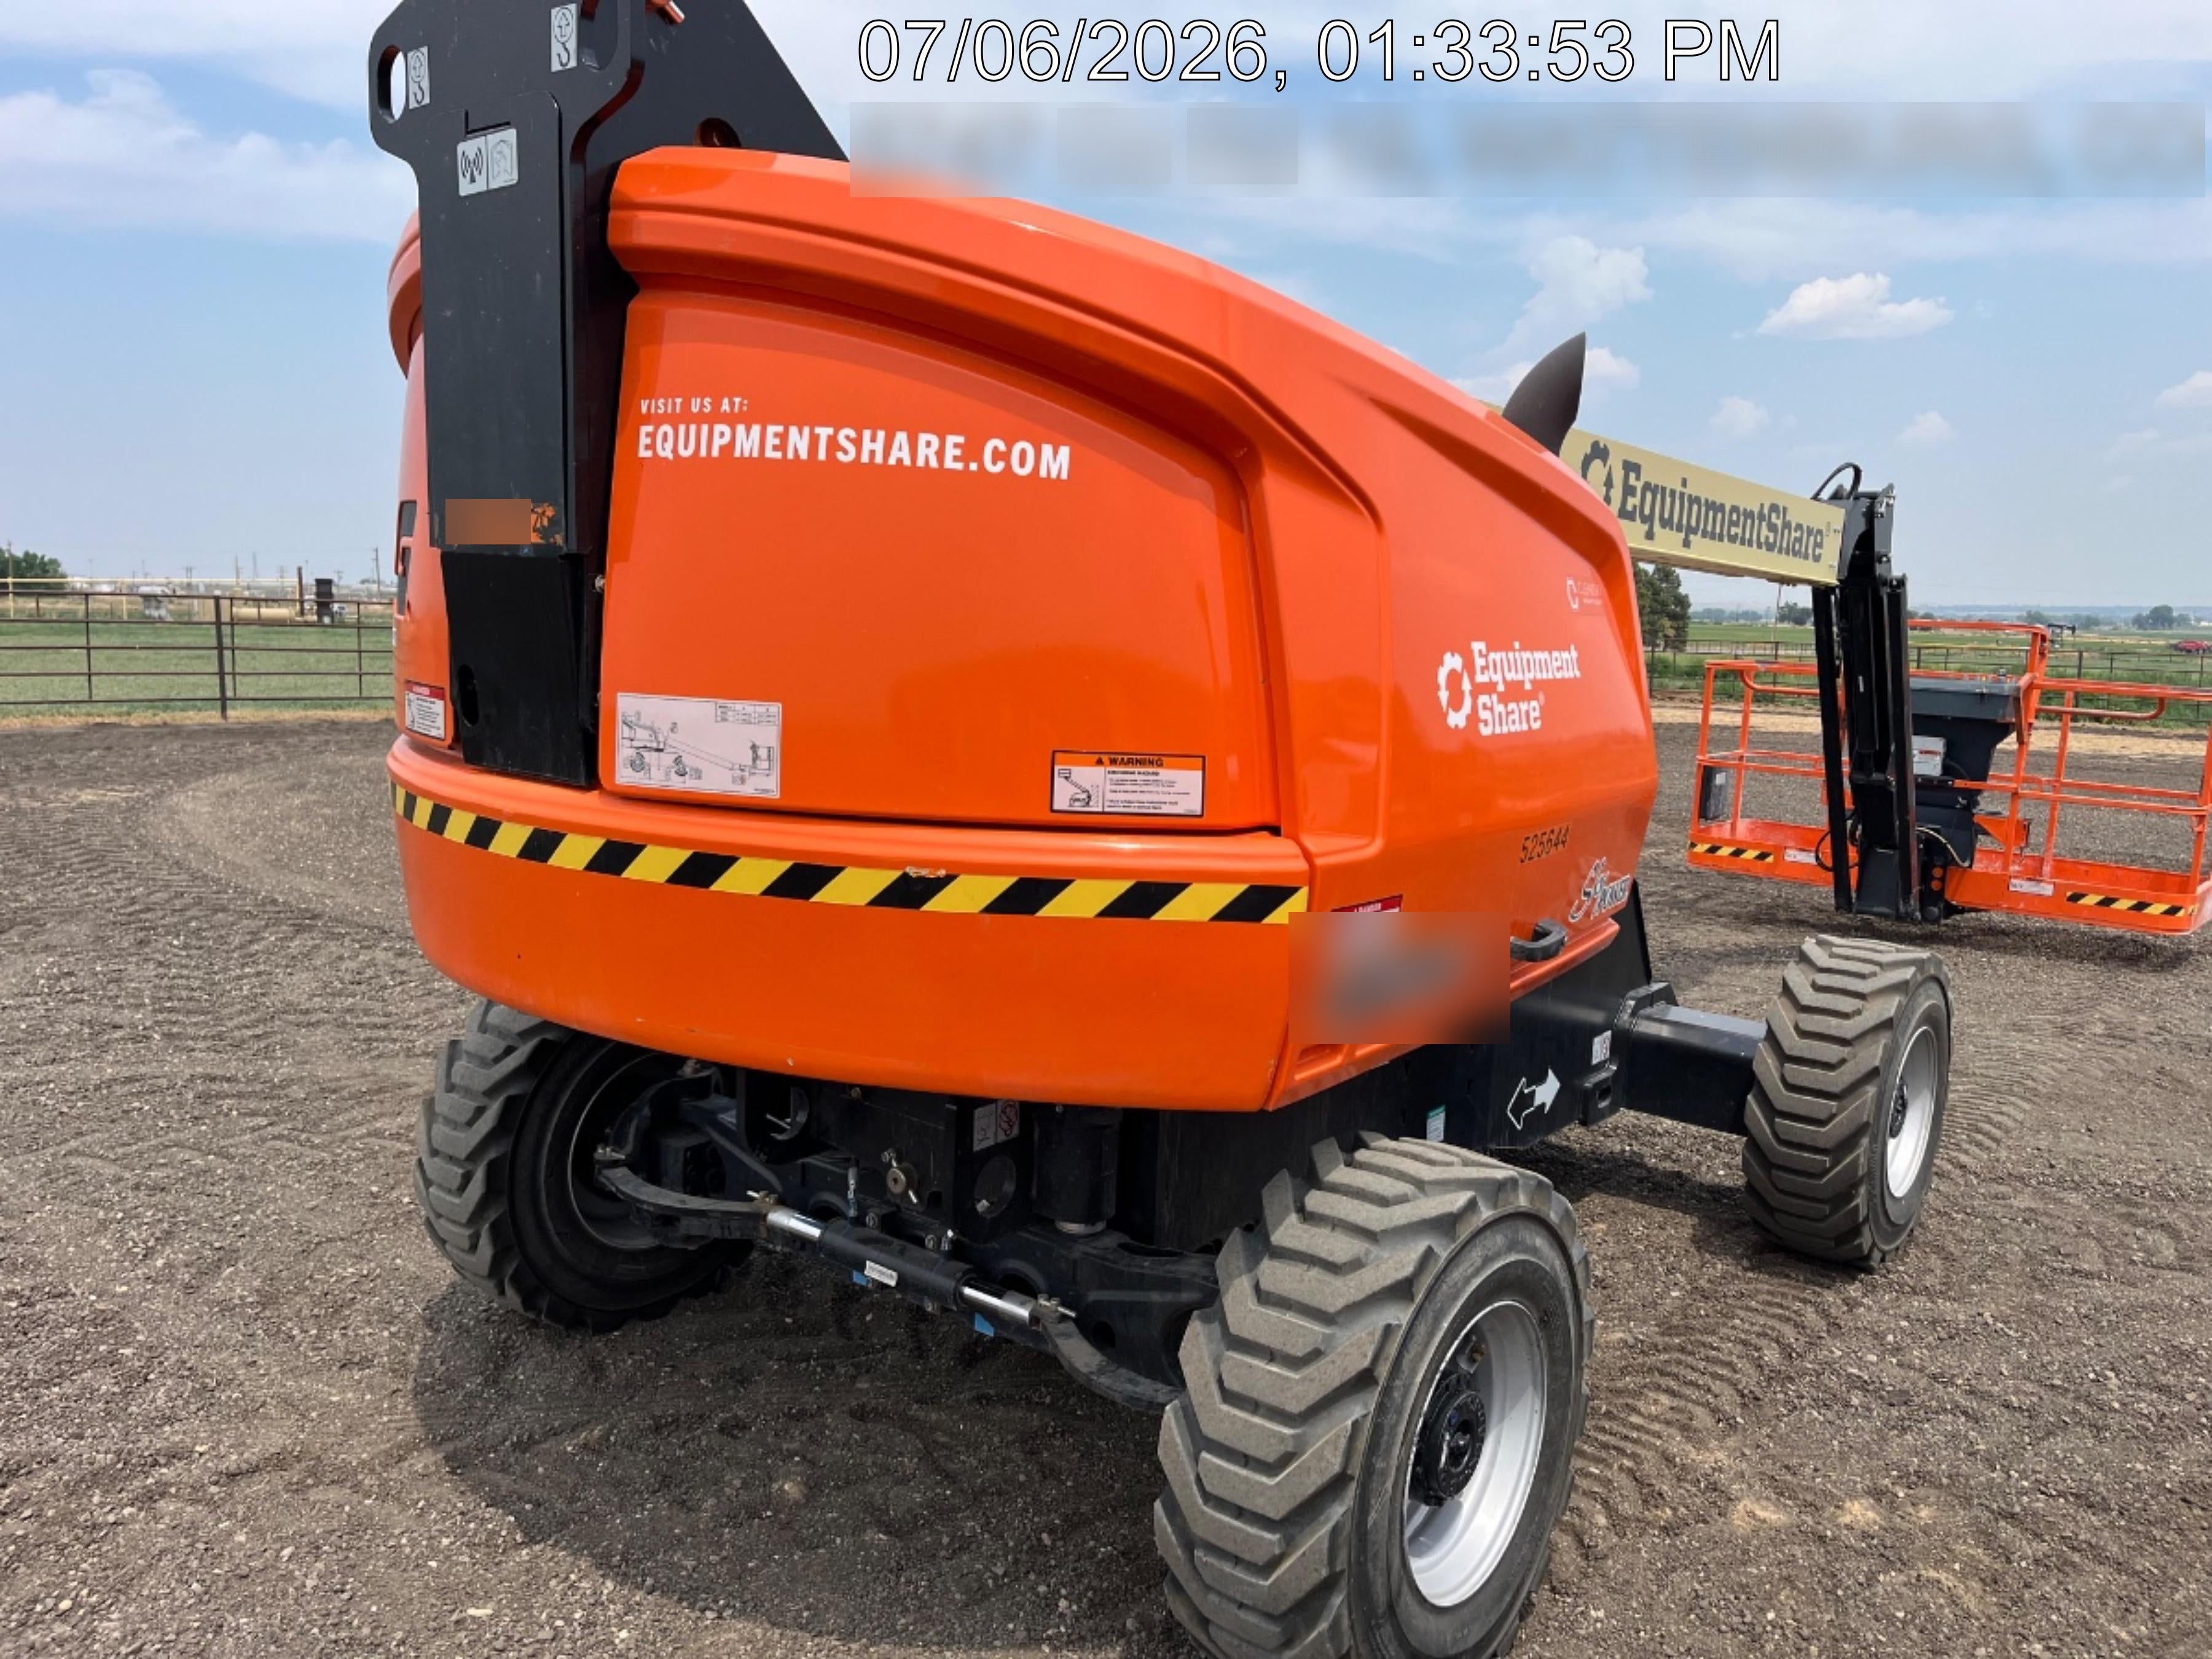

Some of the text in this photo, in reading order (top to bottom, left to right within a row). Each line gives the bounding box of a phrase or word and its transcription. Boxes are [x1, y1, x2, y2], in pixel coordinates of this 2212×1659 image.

[640, 397, 749, 414] VISIT US AT:
[637, 424, 1070, 479] EQUIPMENTSHARE.COM
[1618, 460, 1824, 562] EquipmentShare
[1470, 641, 1580, 691] Equipment
[1478, 694, 1541, 736] Share
[1108, 756, 1164, 767] WARNING
